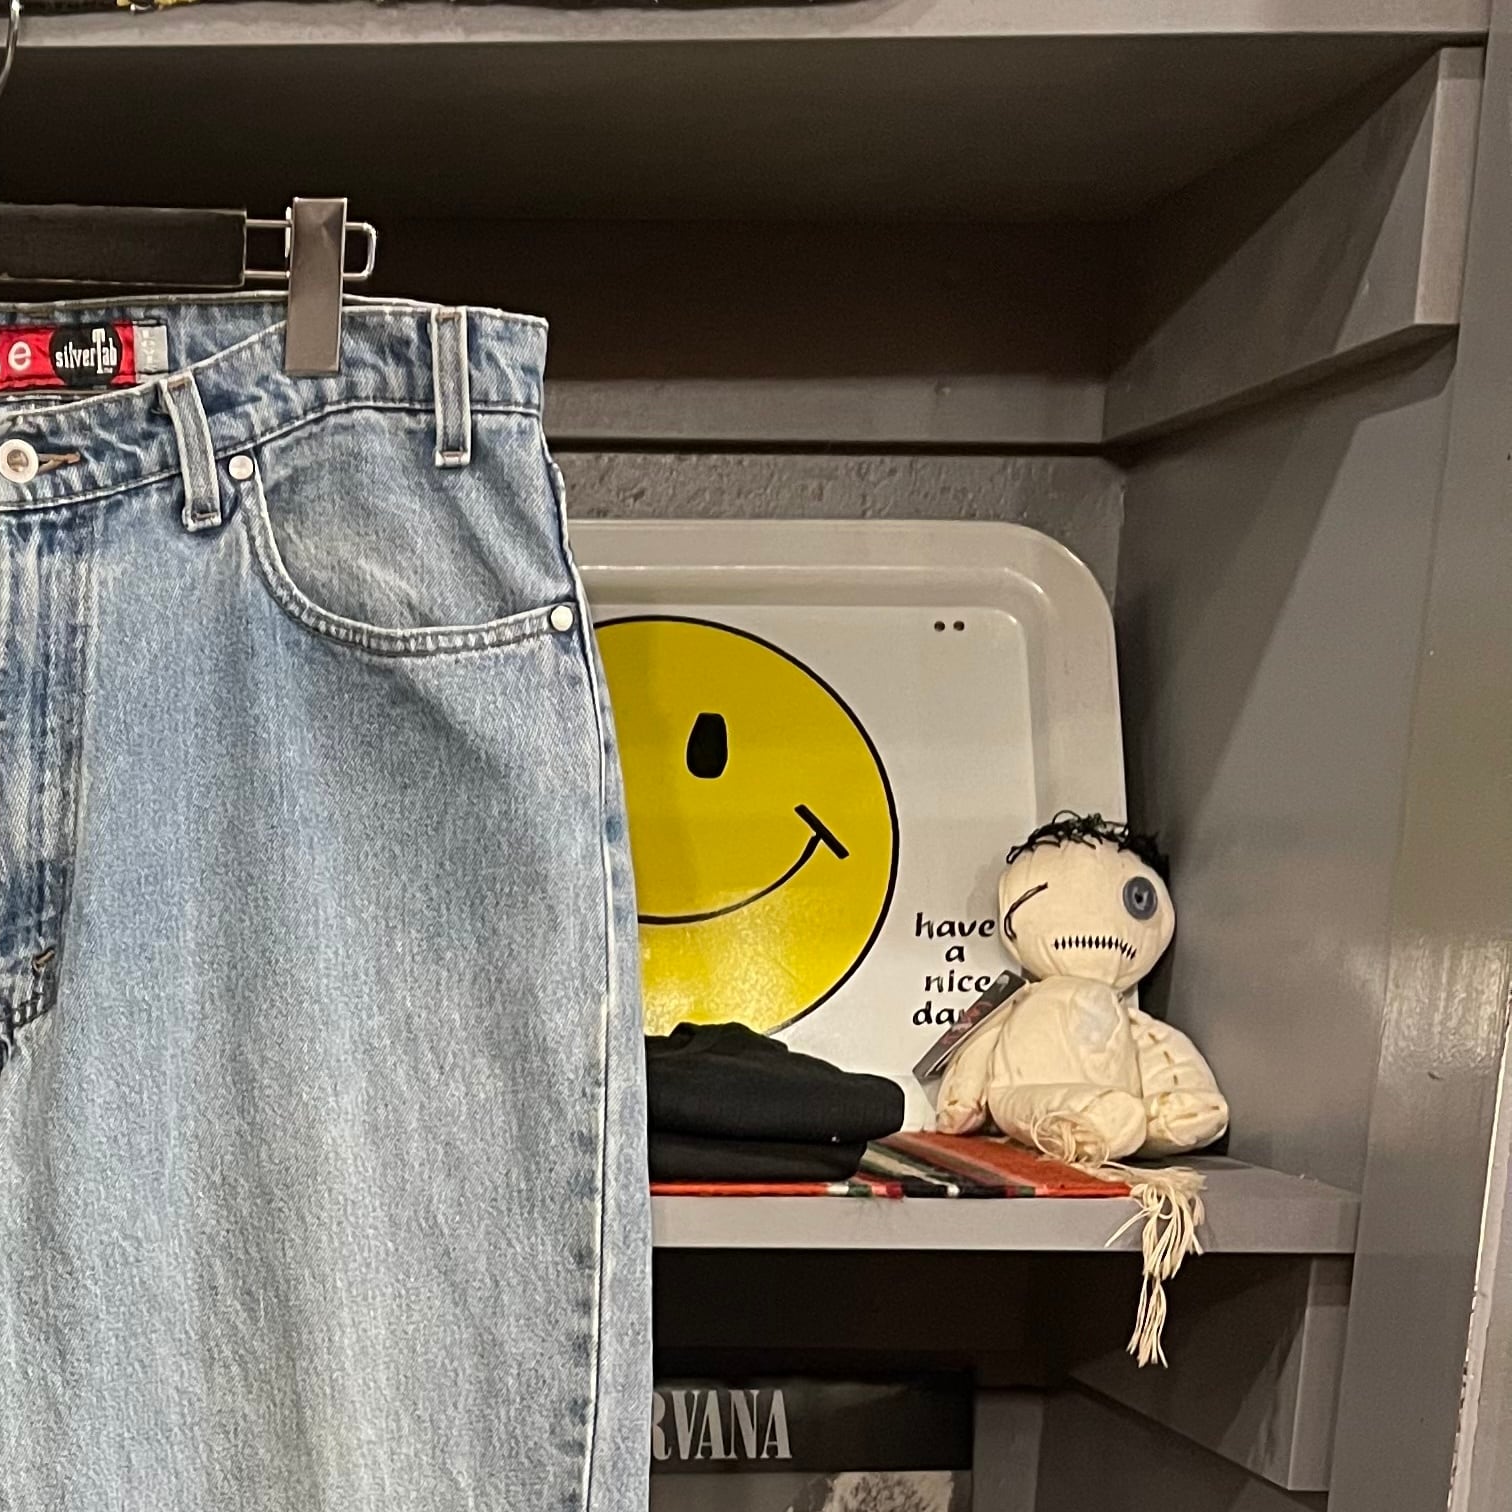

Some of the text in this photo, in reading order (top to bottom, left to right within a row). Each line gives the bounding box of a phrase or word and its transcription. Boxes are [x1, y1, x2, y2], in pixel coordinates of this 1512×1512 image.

[915, 912, 996, 940] have
[945, 945, 966, 963] a
[924, 970, 992, 993] nice
[912, 1001, 966, 1026] da
[651, 1388, 793, 1460] RVANA
